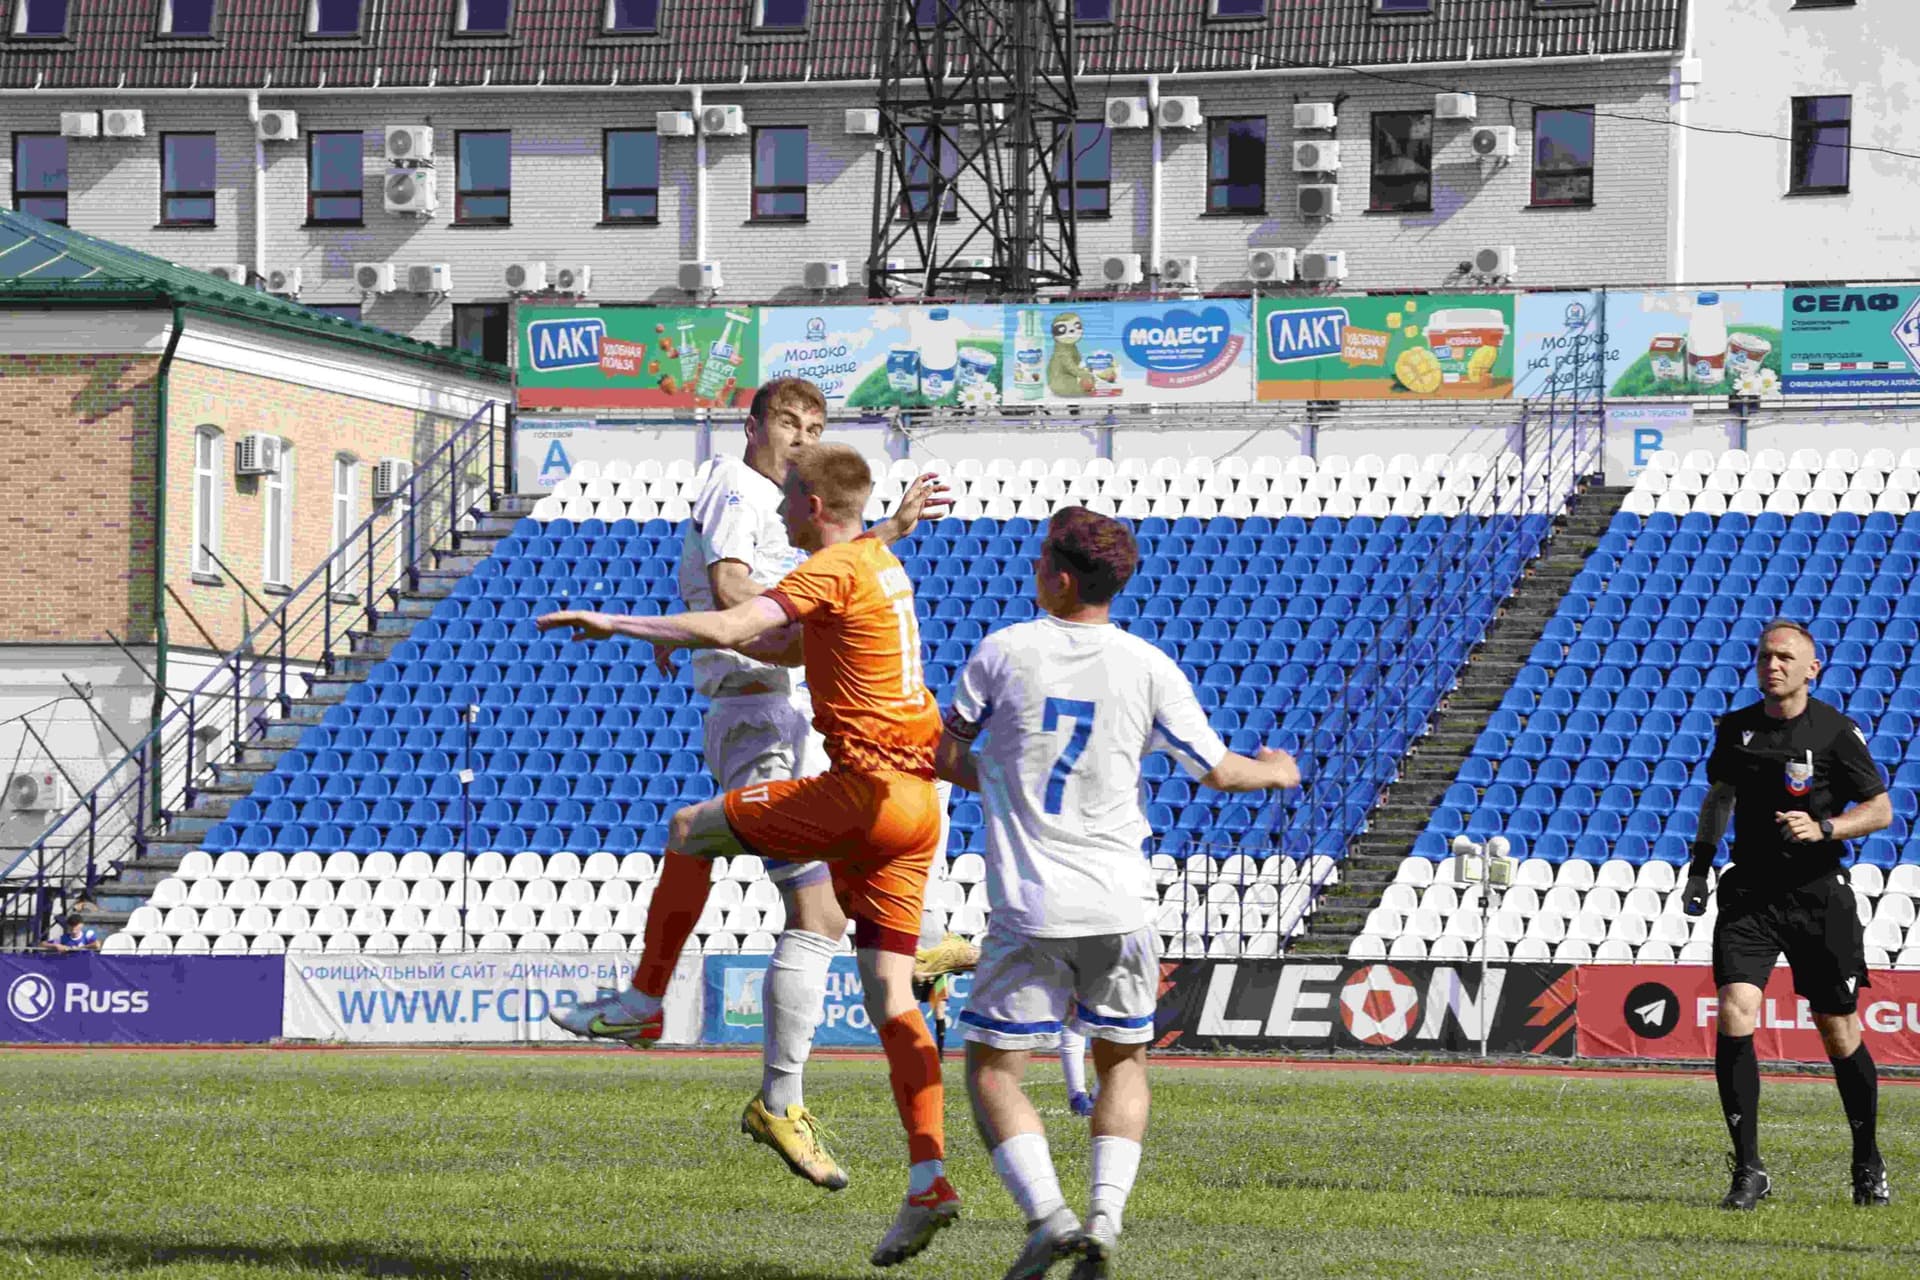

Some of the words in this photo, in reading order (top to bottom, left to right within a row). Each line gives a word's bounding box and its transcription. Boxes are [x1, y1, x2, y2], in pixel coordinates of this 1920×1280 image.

[1792, 293, 1899, 313] СЕЛФ
[540, 325, 601, 361] ЛАКТ
[1129, 326, 1224, 347] МОДЕСТ
[1278, 314, 1345, 353] ЛАКТ
[1541, 332, 1609, 350] Молоко
[784, 345, 847, 362] Молоко
[1527, 356, 1549, 369] на
[1555, 349, 1620, 373] разные
[798, 361, 857, 378] разные
[1042, 697, 1096, 815] 7
[301, 962, 445, 982] ОФИЦИАЛЬНЫЙ
[451, 961, 497, 979] САЙТ
[503, 963, 685, 982] «ДИНАМО-БАР»
[64, 983, 149, 1013] Russ
[1197, 964, 1507, 1045] LEON
